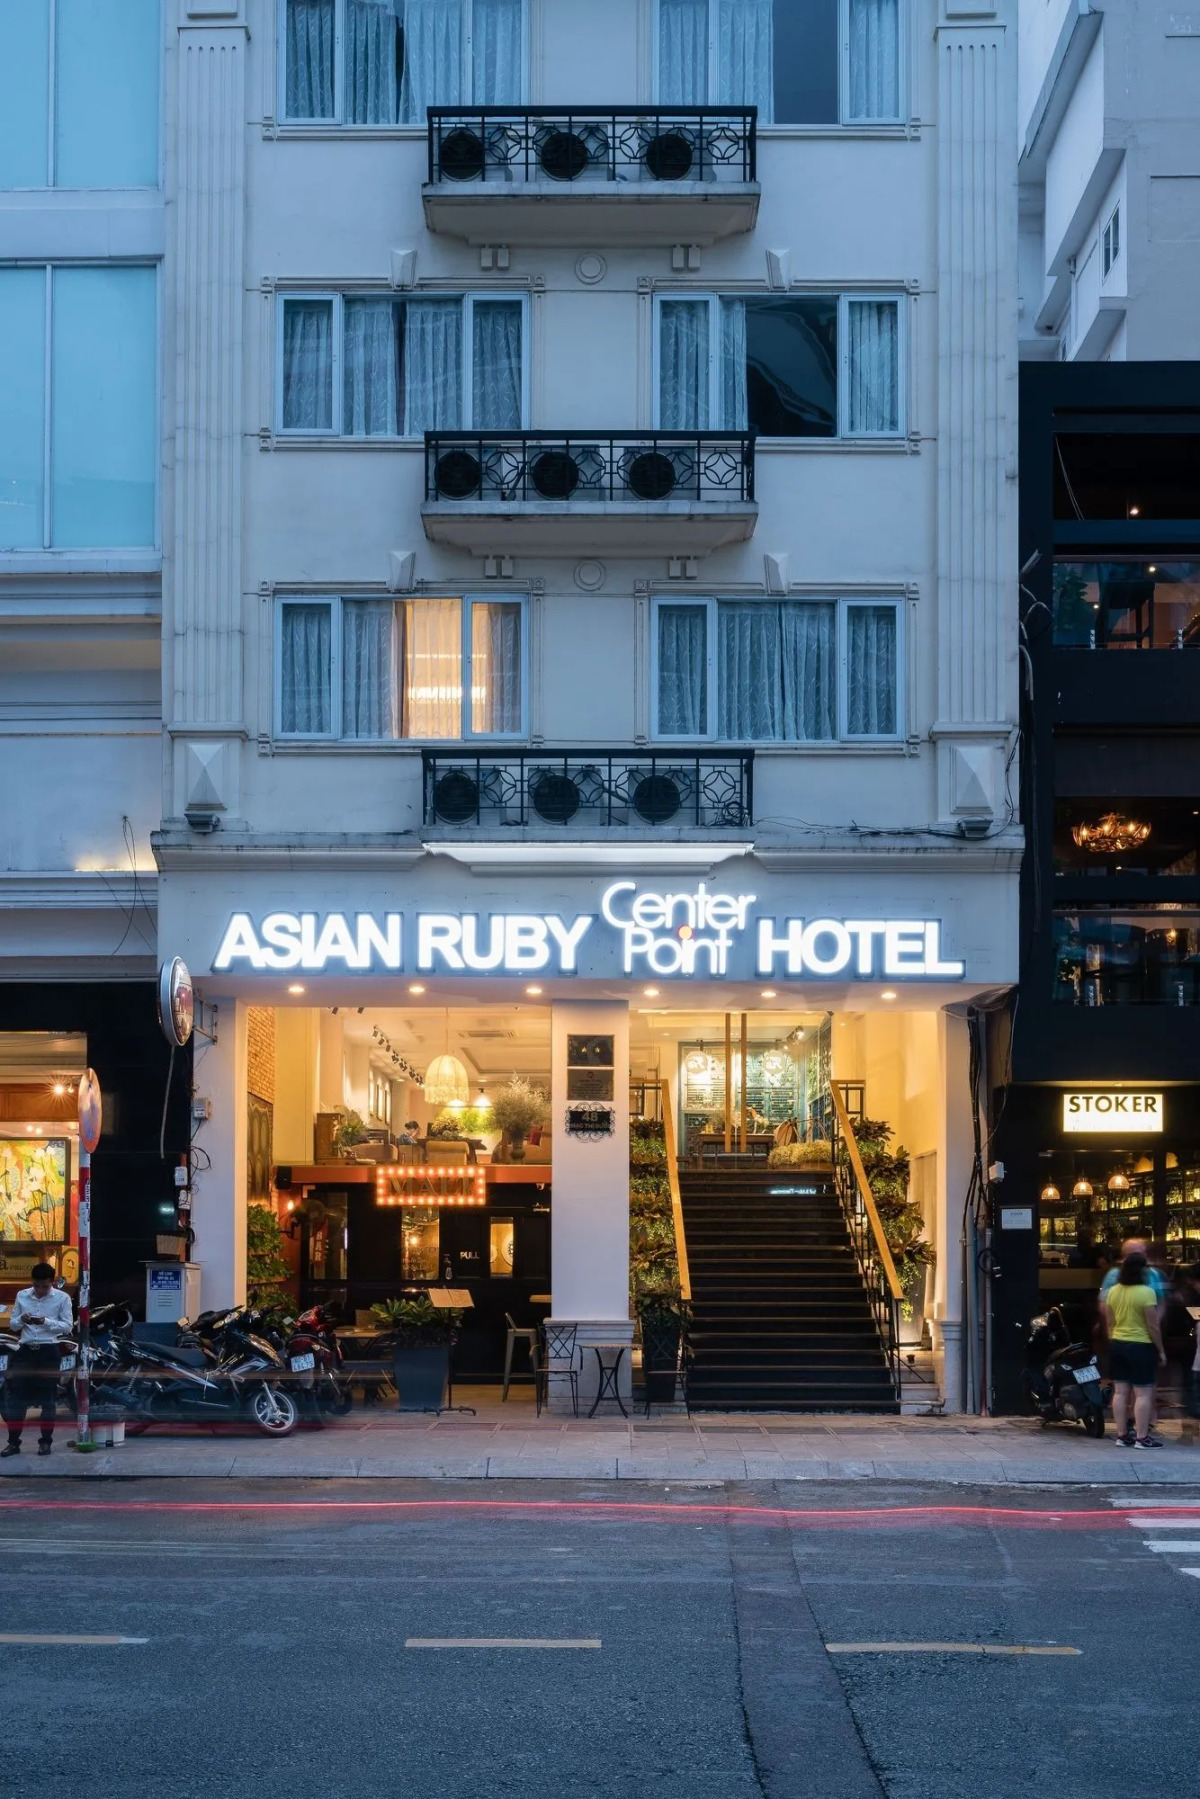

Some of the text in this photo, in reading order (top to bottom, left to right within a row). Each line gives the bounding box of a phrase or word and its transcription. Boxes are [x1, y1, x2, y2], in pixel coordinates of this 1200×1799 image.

[601, 881, 758, 931] Center
[213, 912, 595, 972] ASIAN RUBY
[623, 926, 734, 976] Point
[758, 918, 965, 976] HOTEL
[582, 1111, 598, 1121] 48
[1069, 1096, 1157, 1112] STOKER
[460, 1251, 479, 1259] PULL
